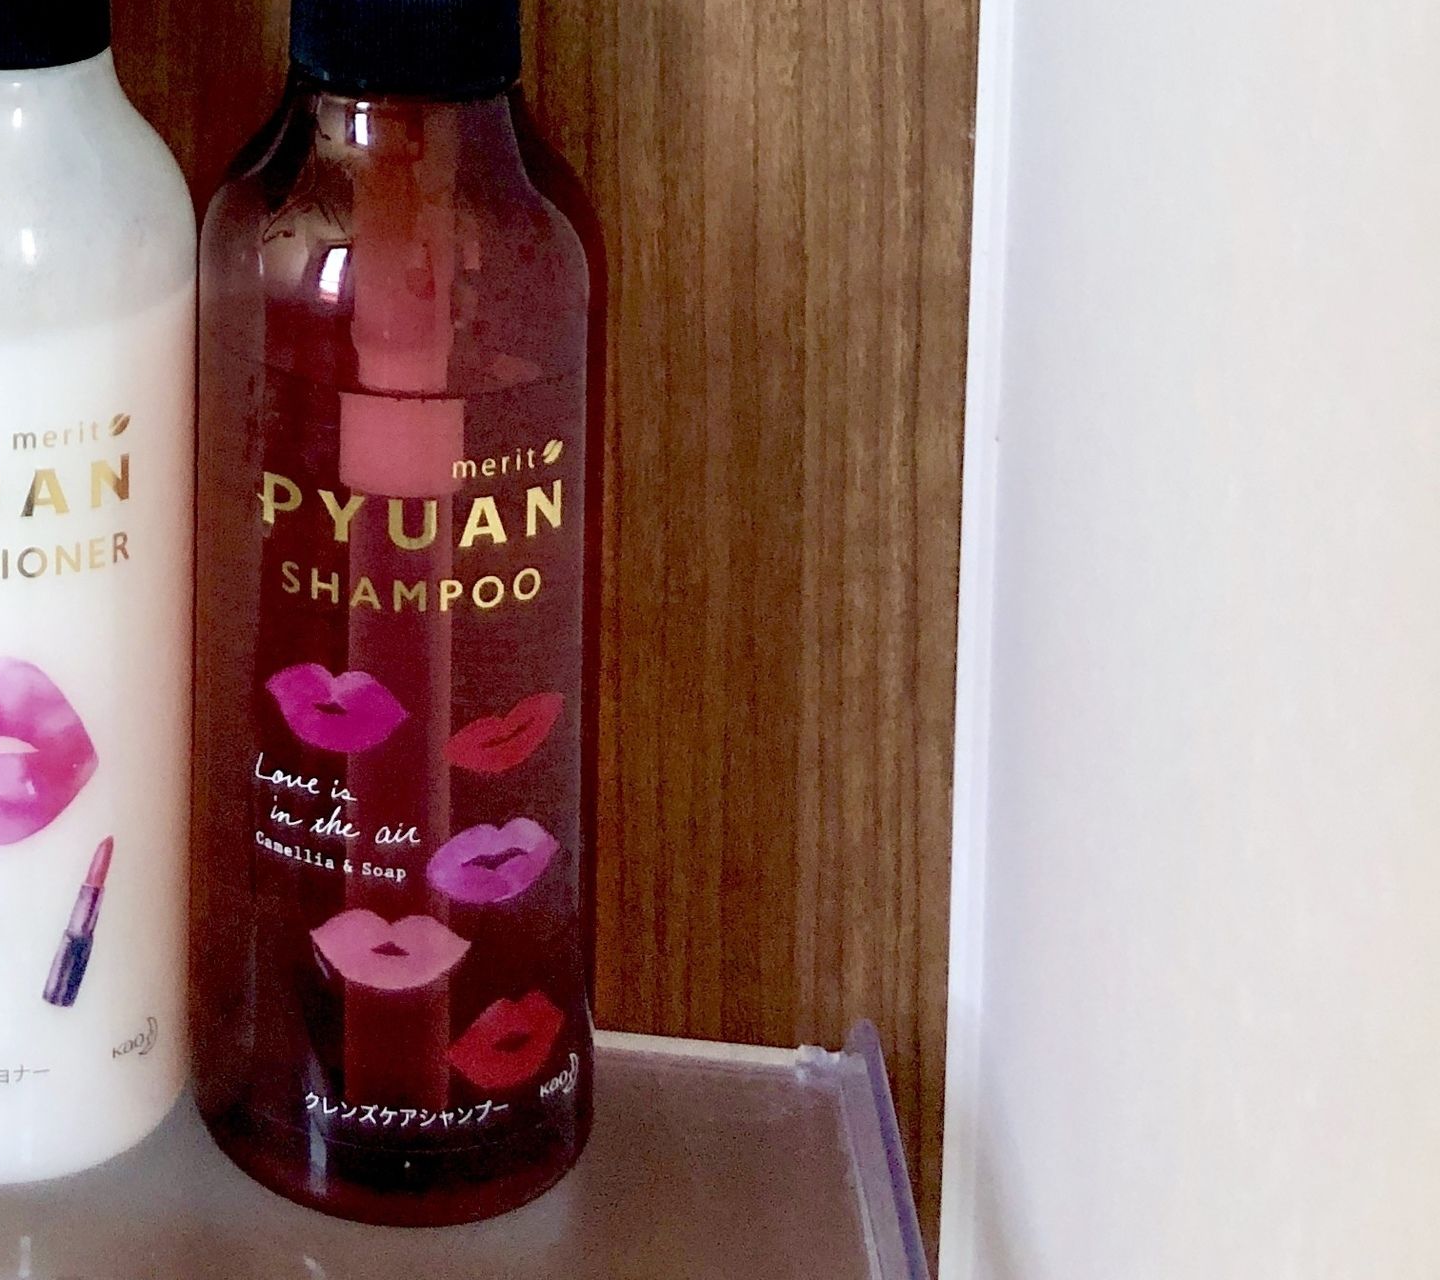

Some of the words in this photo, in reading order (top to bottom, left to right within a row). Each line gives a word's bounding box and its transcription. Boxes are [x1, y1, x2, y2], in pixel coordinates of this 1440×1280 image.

[12, 420, 99, 450] merit
[452, 447, 535, 480] merit
[257, 478, 563, 551] PYUAN
[281, 560, 542, 613] SHAMPOO
[255, 752, 320, 794] Love
[331, 779, 358, 801] is
[270, 795, 303, 825] in
[309, 806, 361, 837] the
[375, 823, 421, 844] air
[255, 831, 335, 870] Camellia
[343, 859, 353, 874] &
[361, 862, 407, 882] Soap
[304, 1091, 510, 1128] クレンズケアシャンプー
